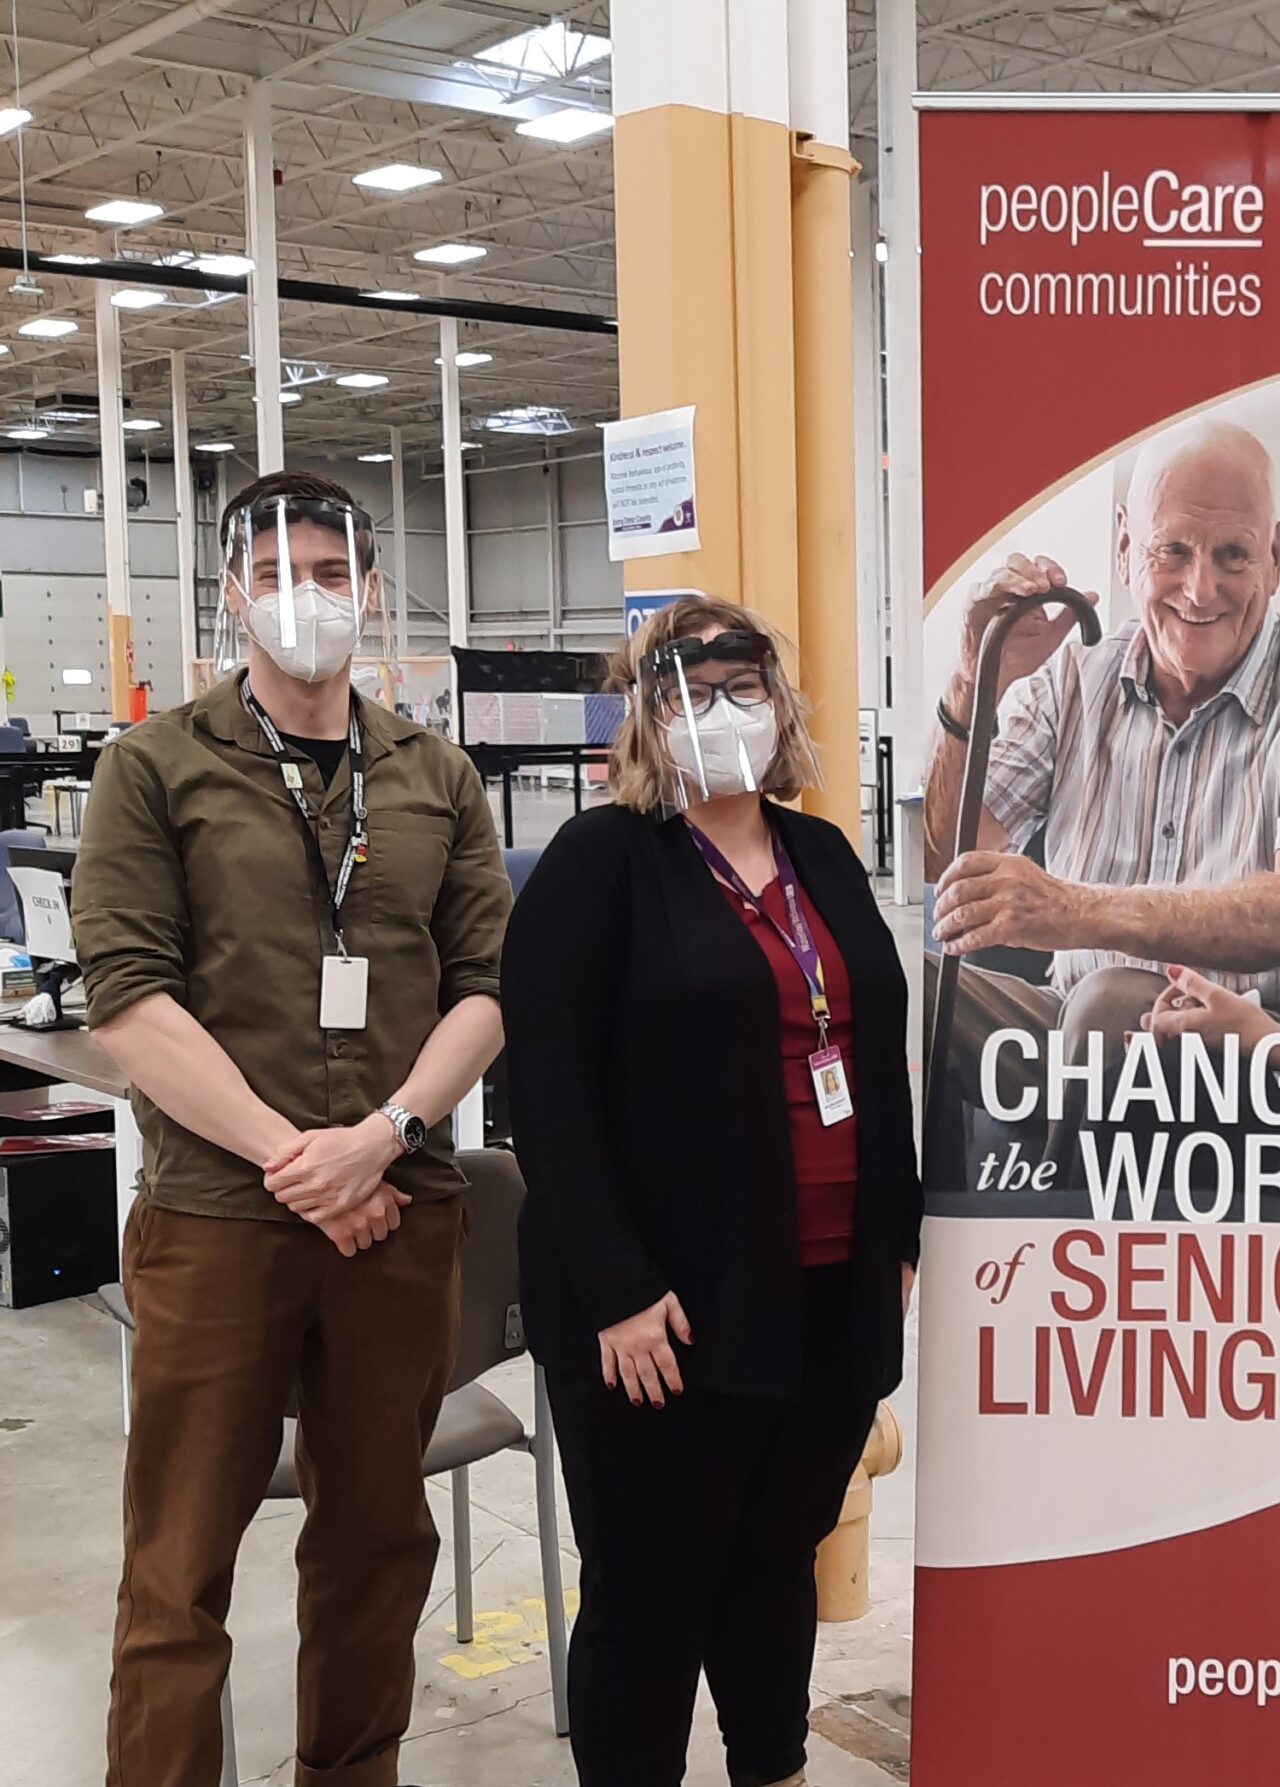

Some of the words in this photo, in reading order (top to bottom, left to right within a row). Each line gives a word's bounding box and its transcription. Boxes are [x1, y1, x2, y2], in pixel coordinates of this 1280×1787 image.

[979, 169, 1264, 246] peopleCare
[979, 261, 1262, 317] communities
[62, 739, 75, 750] 29
[976, 1142, 1058, 1192] the
[975, 1242, 1036, 1305] of
[978, 1326, 1277, 1422] LIVING
